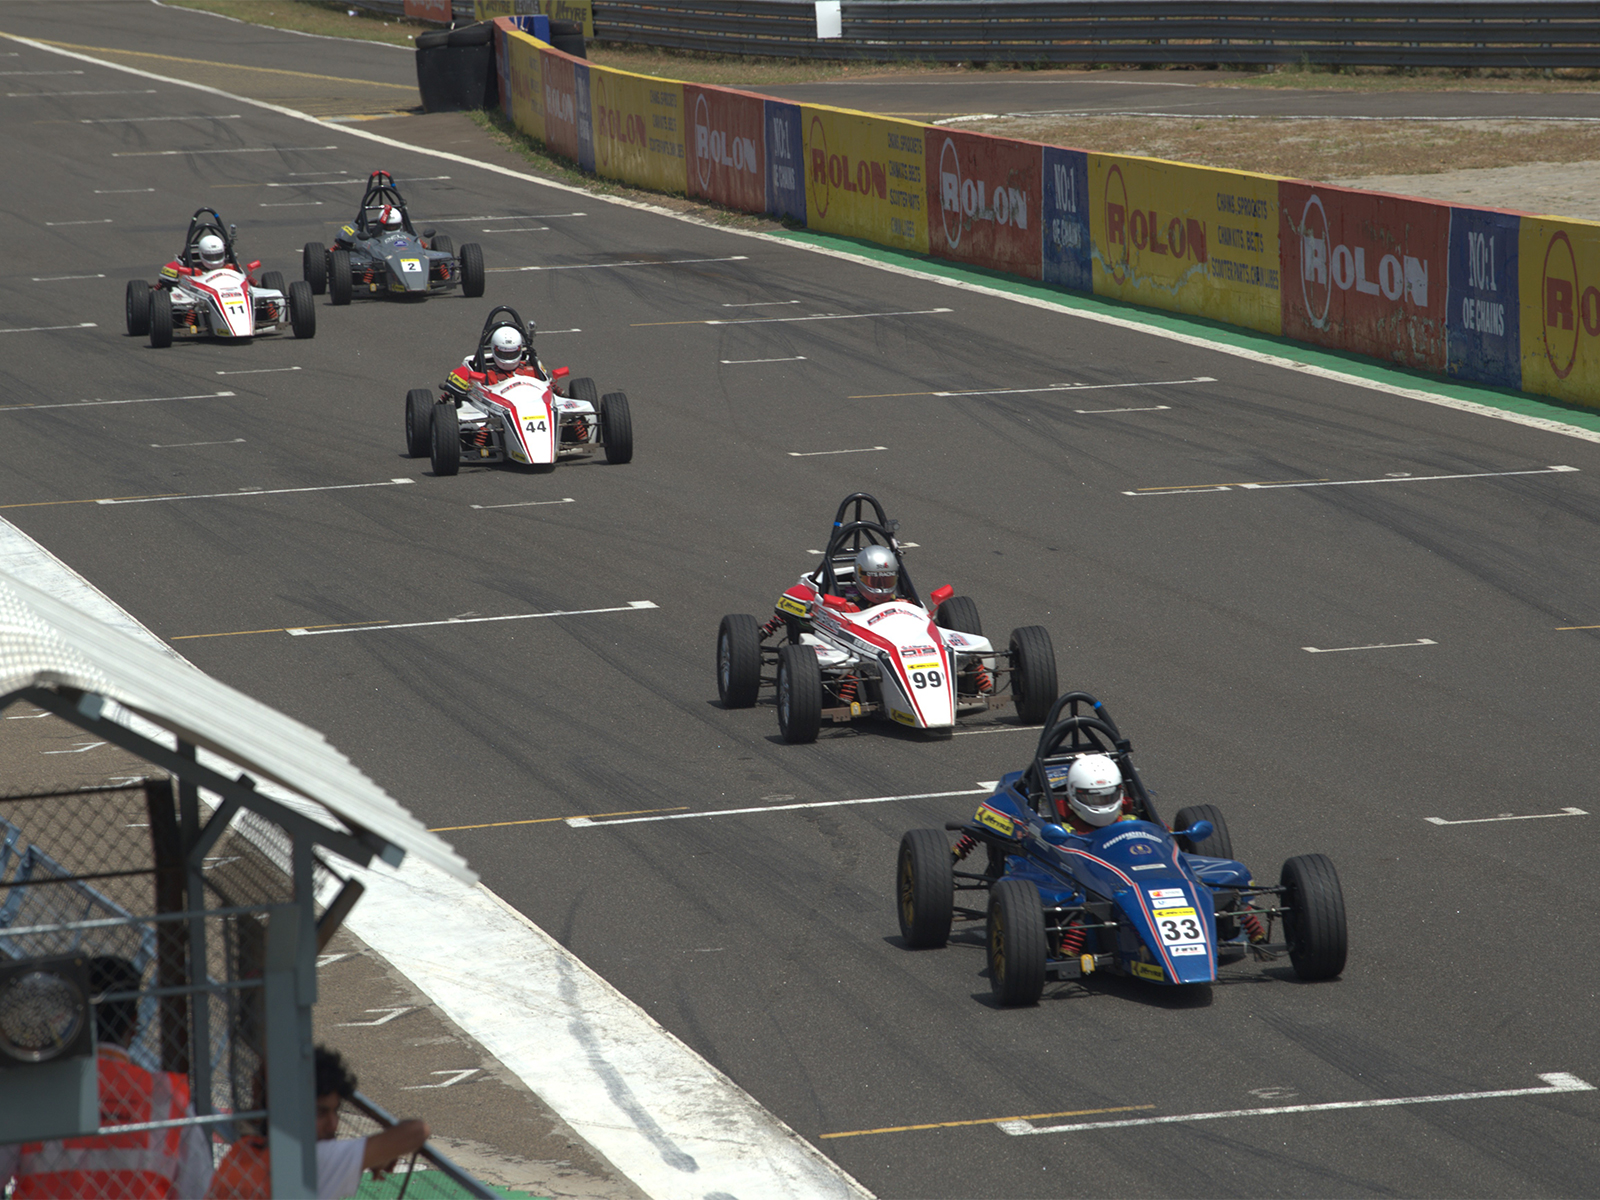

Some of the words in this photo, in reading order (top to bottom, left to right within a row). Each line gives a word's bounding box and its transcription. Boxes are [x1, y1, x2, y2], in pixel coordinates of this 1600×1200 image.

[598, 105, 647, 148] ROLON
[696, 124, 757, 174] ROLON
[811, 147, 887, 200] ROLON
[942, 171, 1027, 230] ROLON
[1107, 202, 1208, 264] ROLON
[1246, 230, 1264, 253] BELTS
[407, 263, 416, 271] 2
[1303, 236, 1428, 308] ROLON
[1468, 231, 1497, 291] NO:1
[228, 305, 245, 315] 11
[1462, 297, 1475, 330] OE
[1475, 299, 1505, 337] CHAINS
[525, 421, 547, 433] 44
[912, 671, 942, 689] 99
[1161, 919, 1200, 941] 33
